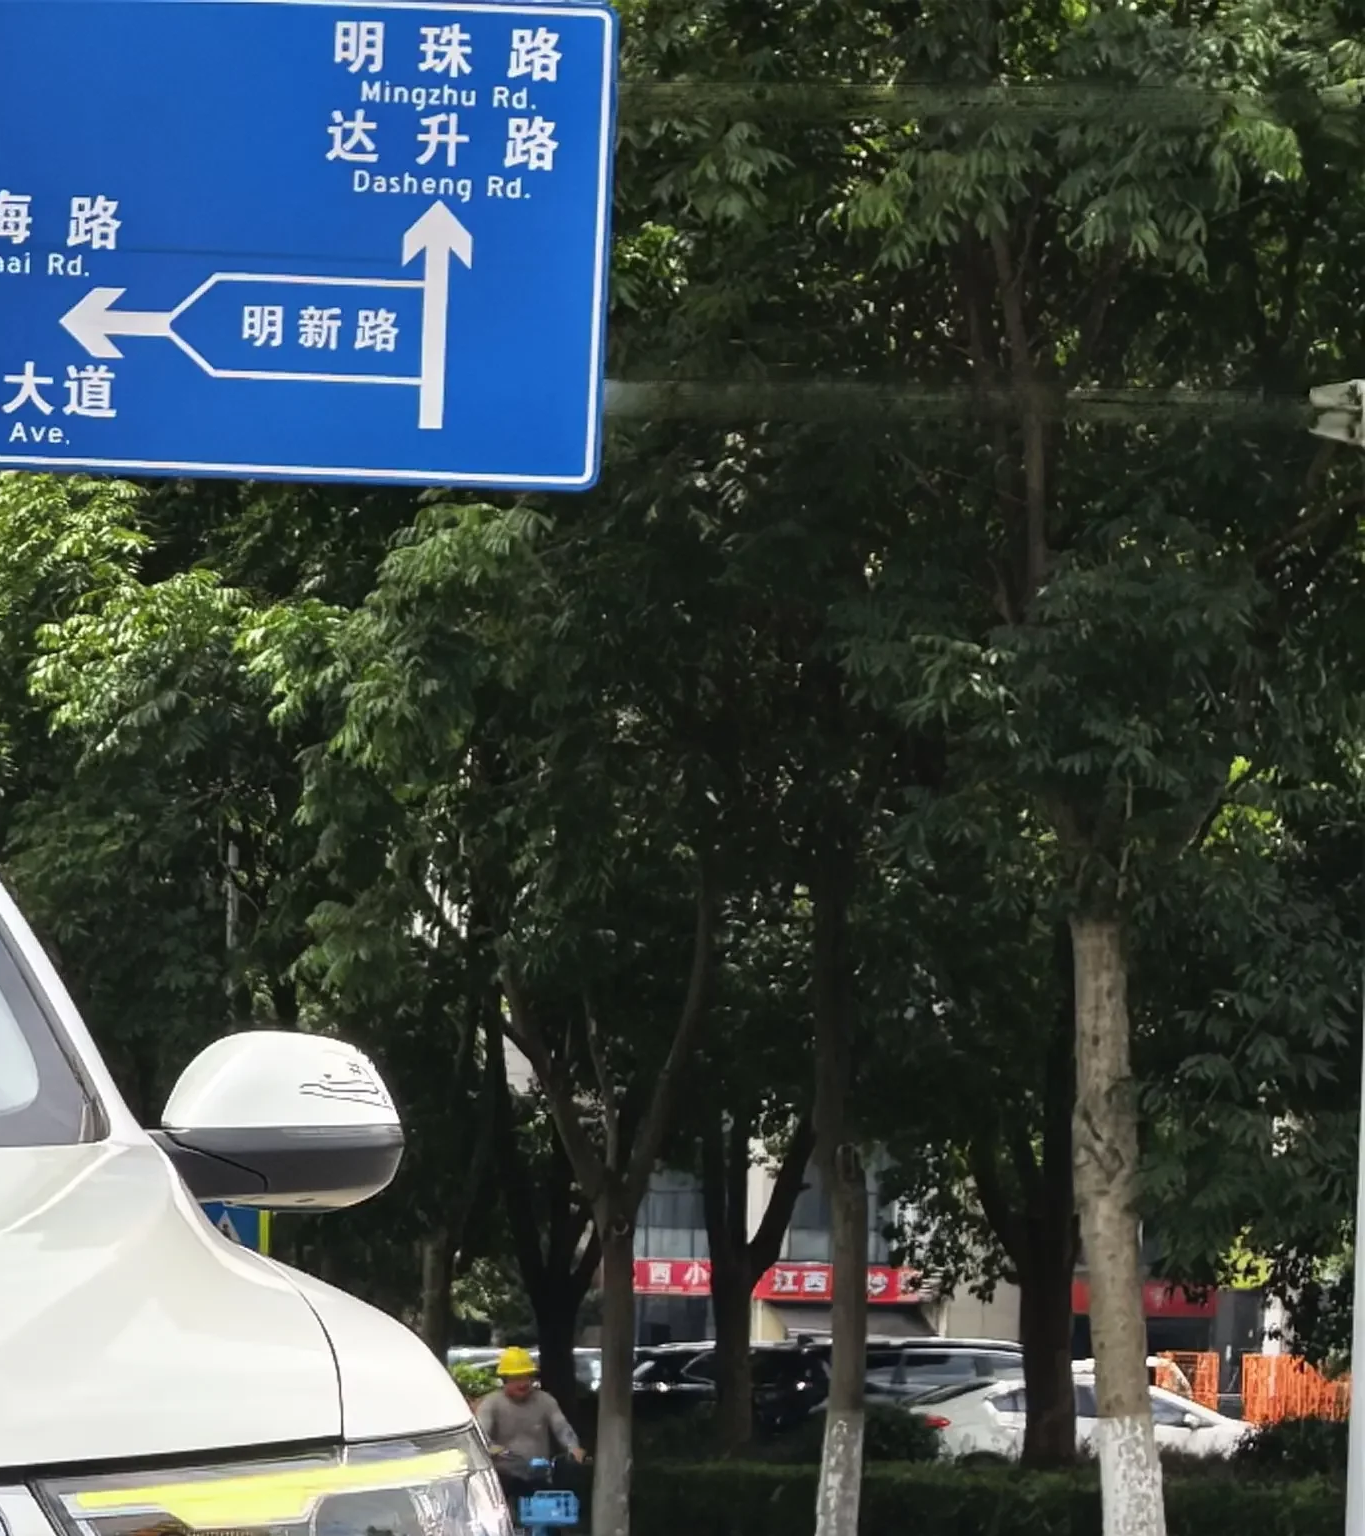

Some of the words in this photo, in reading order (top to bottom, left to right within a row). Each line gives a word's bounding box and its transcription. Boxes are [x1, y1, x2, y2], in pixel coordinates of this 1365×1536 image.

[334, 20, 562, 82] 明珠路
[360, 80, 476, 111] Mingzhu
[492, 86, 536, 110] Rd.
[325, 109, 559, 171] 达升路
[353, 170, 472, 201] Dasheng
[487, 175, 531, 199] Rd.
[47, 253, 91, 277] Rd.
[242, 304, 399, 352] 明新路
[9, 421, 71, 445] Ave.
